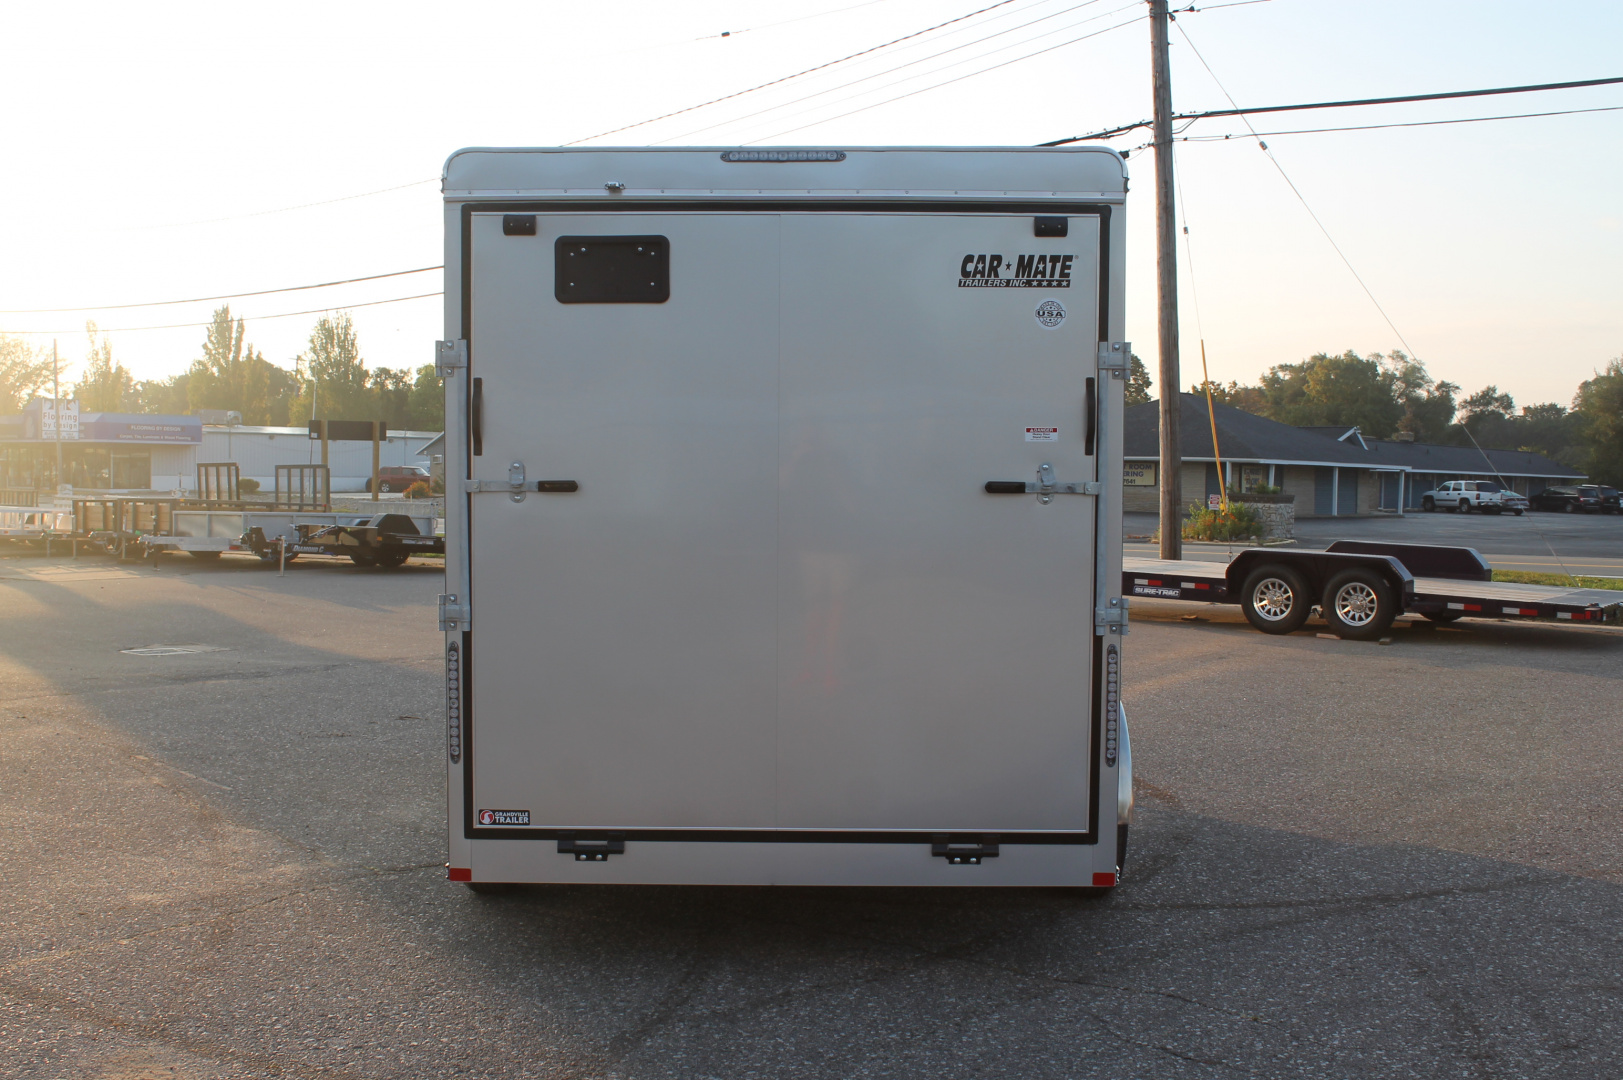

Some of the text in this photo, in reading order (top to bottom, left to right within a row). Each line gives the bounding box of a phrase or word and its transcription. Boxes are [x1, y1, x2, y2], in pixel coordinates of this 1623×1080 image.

[960, 254, 1074, 278] CAR MATE
[960, 279, 1029, 287] TRAILERS INC.
[43, 411, 78, 423] Floring
[43, 421, 52, 429] by
[1135, 588, 1179, 596] SURE-TRAC
